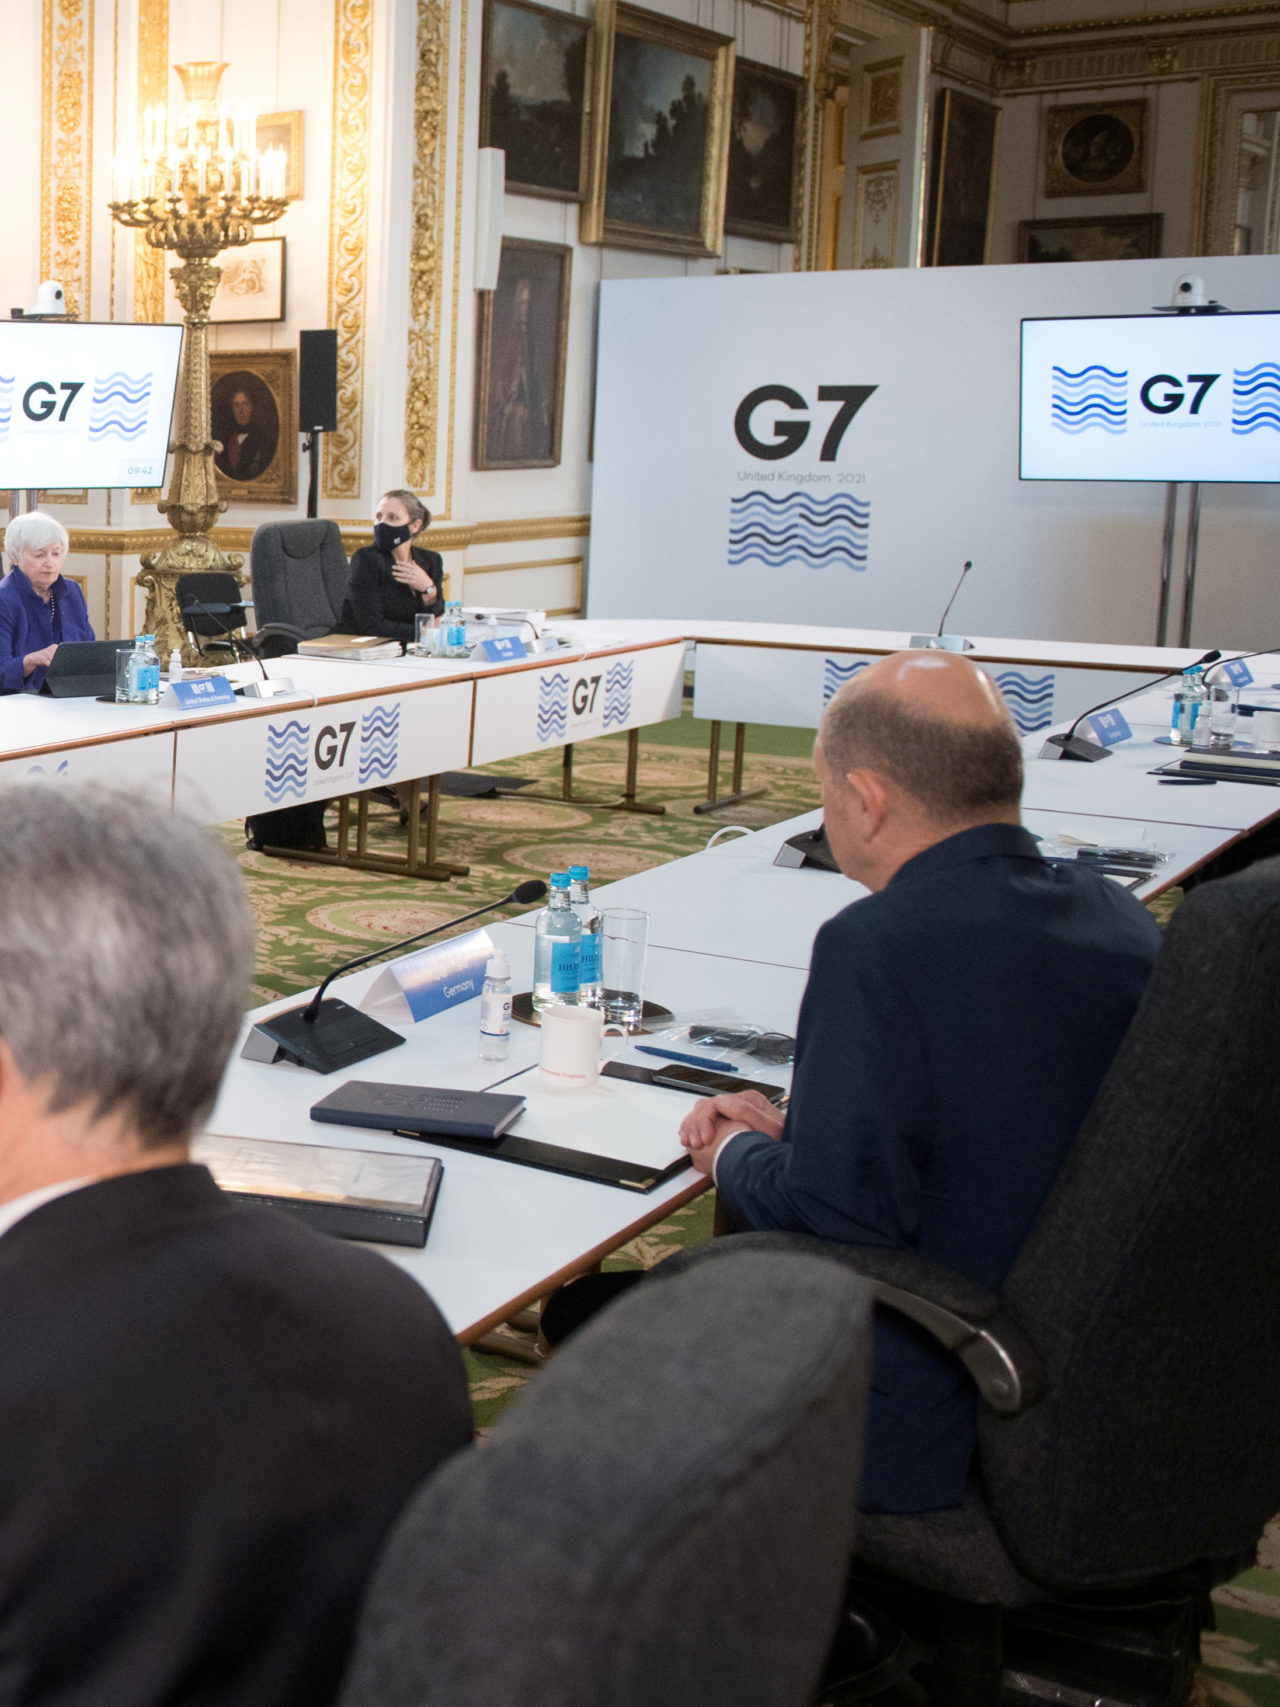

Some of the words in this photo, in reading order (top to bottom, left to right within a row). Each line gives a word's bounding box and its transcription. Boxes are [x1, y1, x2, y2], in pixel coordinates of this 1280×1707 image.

[22, 381, 85, 422] G7
[1140, 374, 1222, 415] G7
[734, 384, 879, 462] G7
[737, 471, 775, 481] United
[778, 471, 831, 486] Kingdom
[837, 472, 866, 484] 2021
[572, 675, 602, 716] G7
[314, 721, 357, 770] G7
[443, 979, 474, 999] Germany
